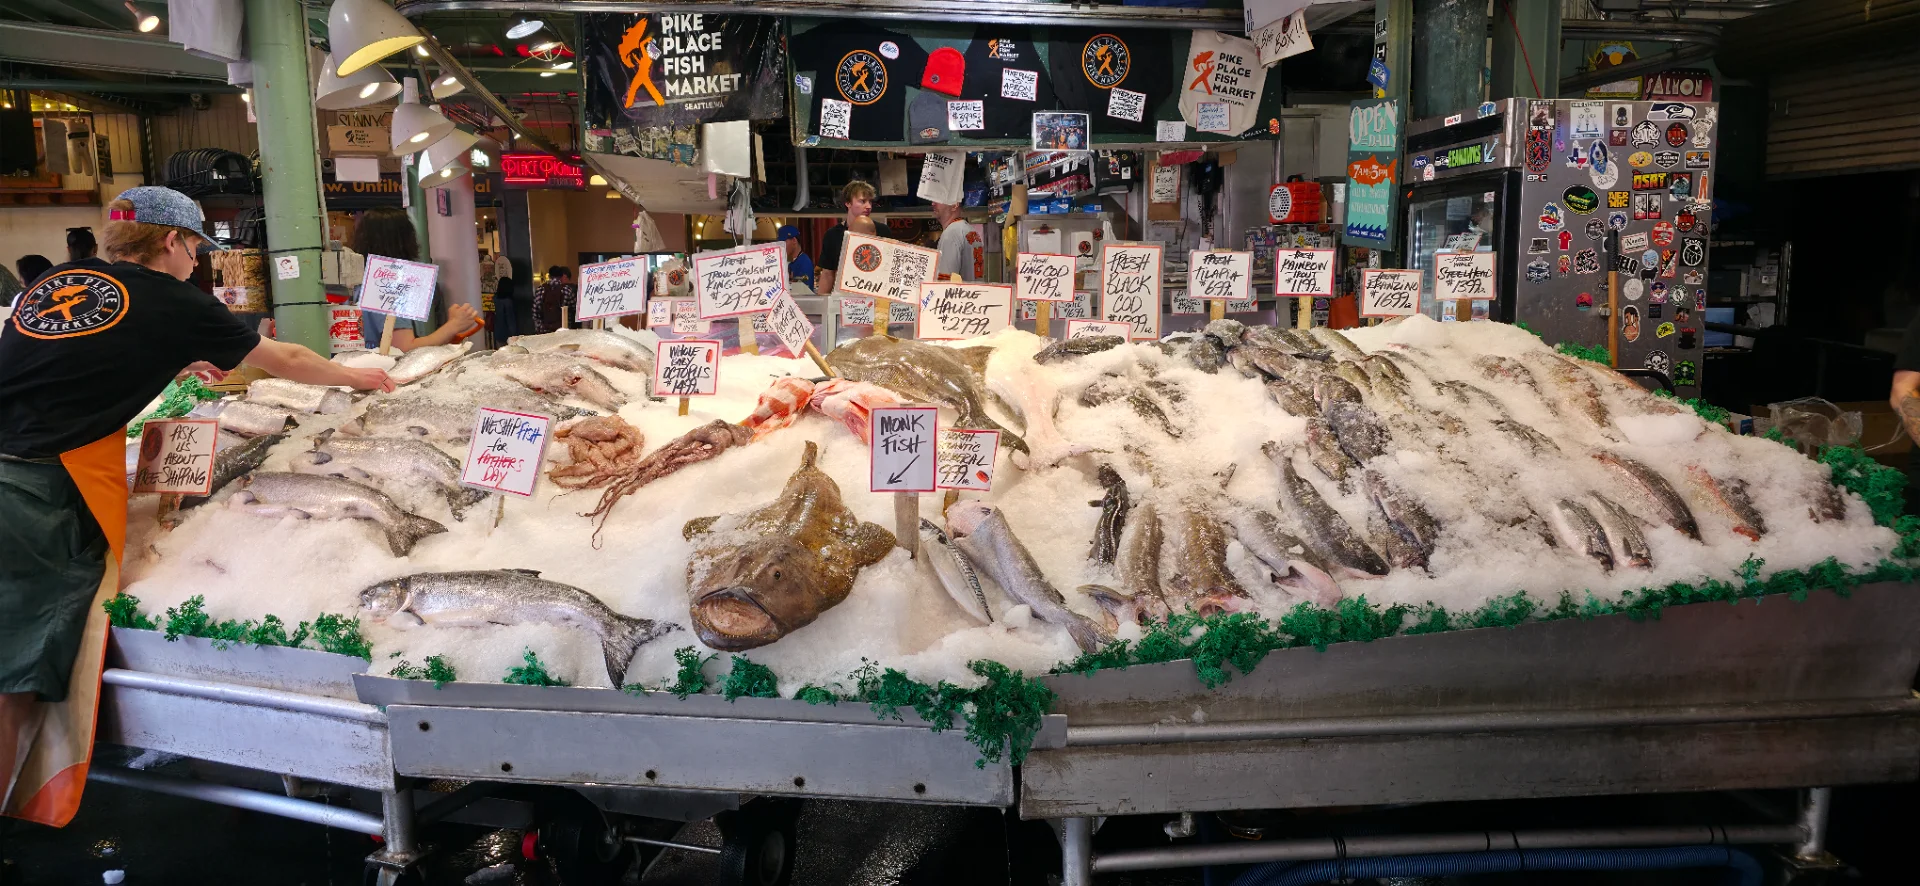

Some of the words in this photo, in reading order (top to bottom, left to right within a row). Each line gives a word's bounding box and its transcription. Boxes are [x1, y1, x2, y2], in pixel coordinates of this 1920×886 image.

[661, 14, 704, 34] PIKE
[662, 32, 723, 55] PLACE
[664, 55, 705, 75] FISH
[1218, 52, 1243, 66] PIKE
[1214, 73, 1238, 87] FISH
[1216, 64, 1252, 78] PLACE
[665, 73, 742, 96] MARKET
[1212, 84, 1257, 100] MARKET
[1645, 73, 1703, 96] SALMON
[338, 113, 383, 128] SUNNY
[1350, 99, 1399, 146] OPEN
[1368, 133, 1399, 148] DAILY
[1447, 144, 1482, 168] SEAHAWKS
[1042, 265, 1070, 278] COD
[1107, 250, 1151, 273] FRESH
[1280, 259, 1329, 272] RAINBOW
[1107, 271, 1152, 295] BLACK
[1192, 266, 1244, 282] TILAPIA
[36, 277, 74, 296] PIKE
[84, 276, 118, 304] PLACE
[845, 276, 882, 294] SCAN
[887, 286, 912, 300] ME
[944, 287, 989, 300] WHOLE
[1112, 294, 1143, 313] COD
[38, 313, 104, 331] MARKET
[170, 424, 200, 444] ASK
[516, 421, 543, 444] FISH
[880, 414, 926, 436] MONK
[176, 441, 191, 453] US
[880, 433, 928, 456] FISH
[164, 452, 210, 466] ABOUT
[157, 466, 206, 487] SHIPPING
[480, 465, 509, 490] DAY
